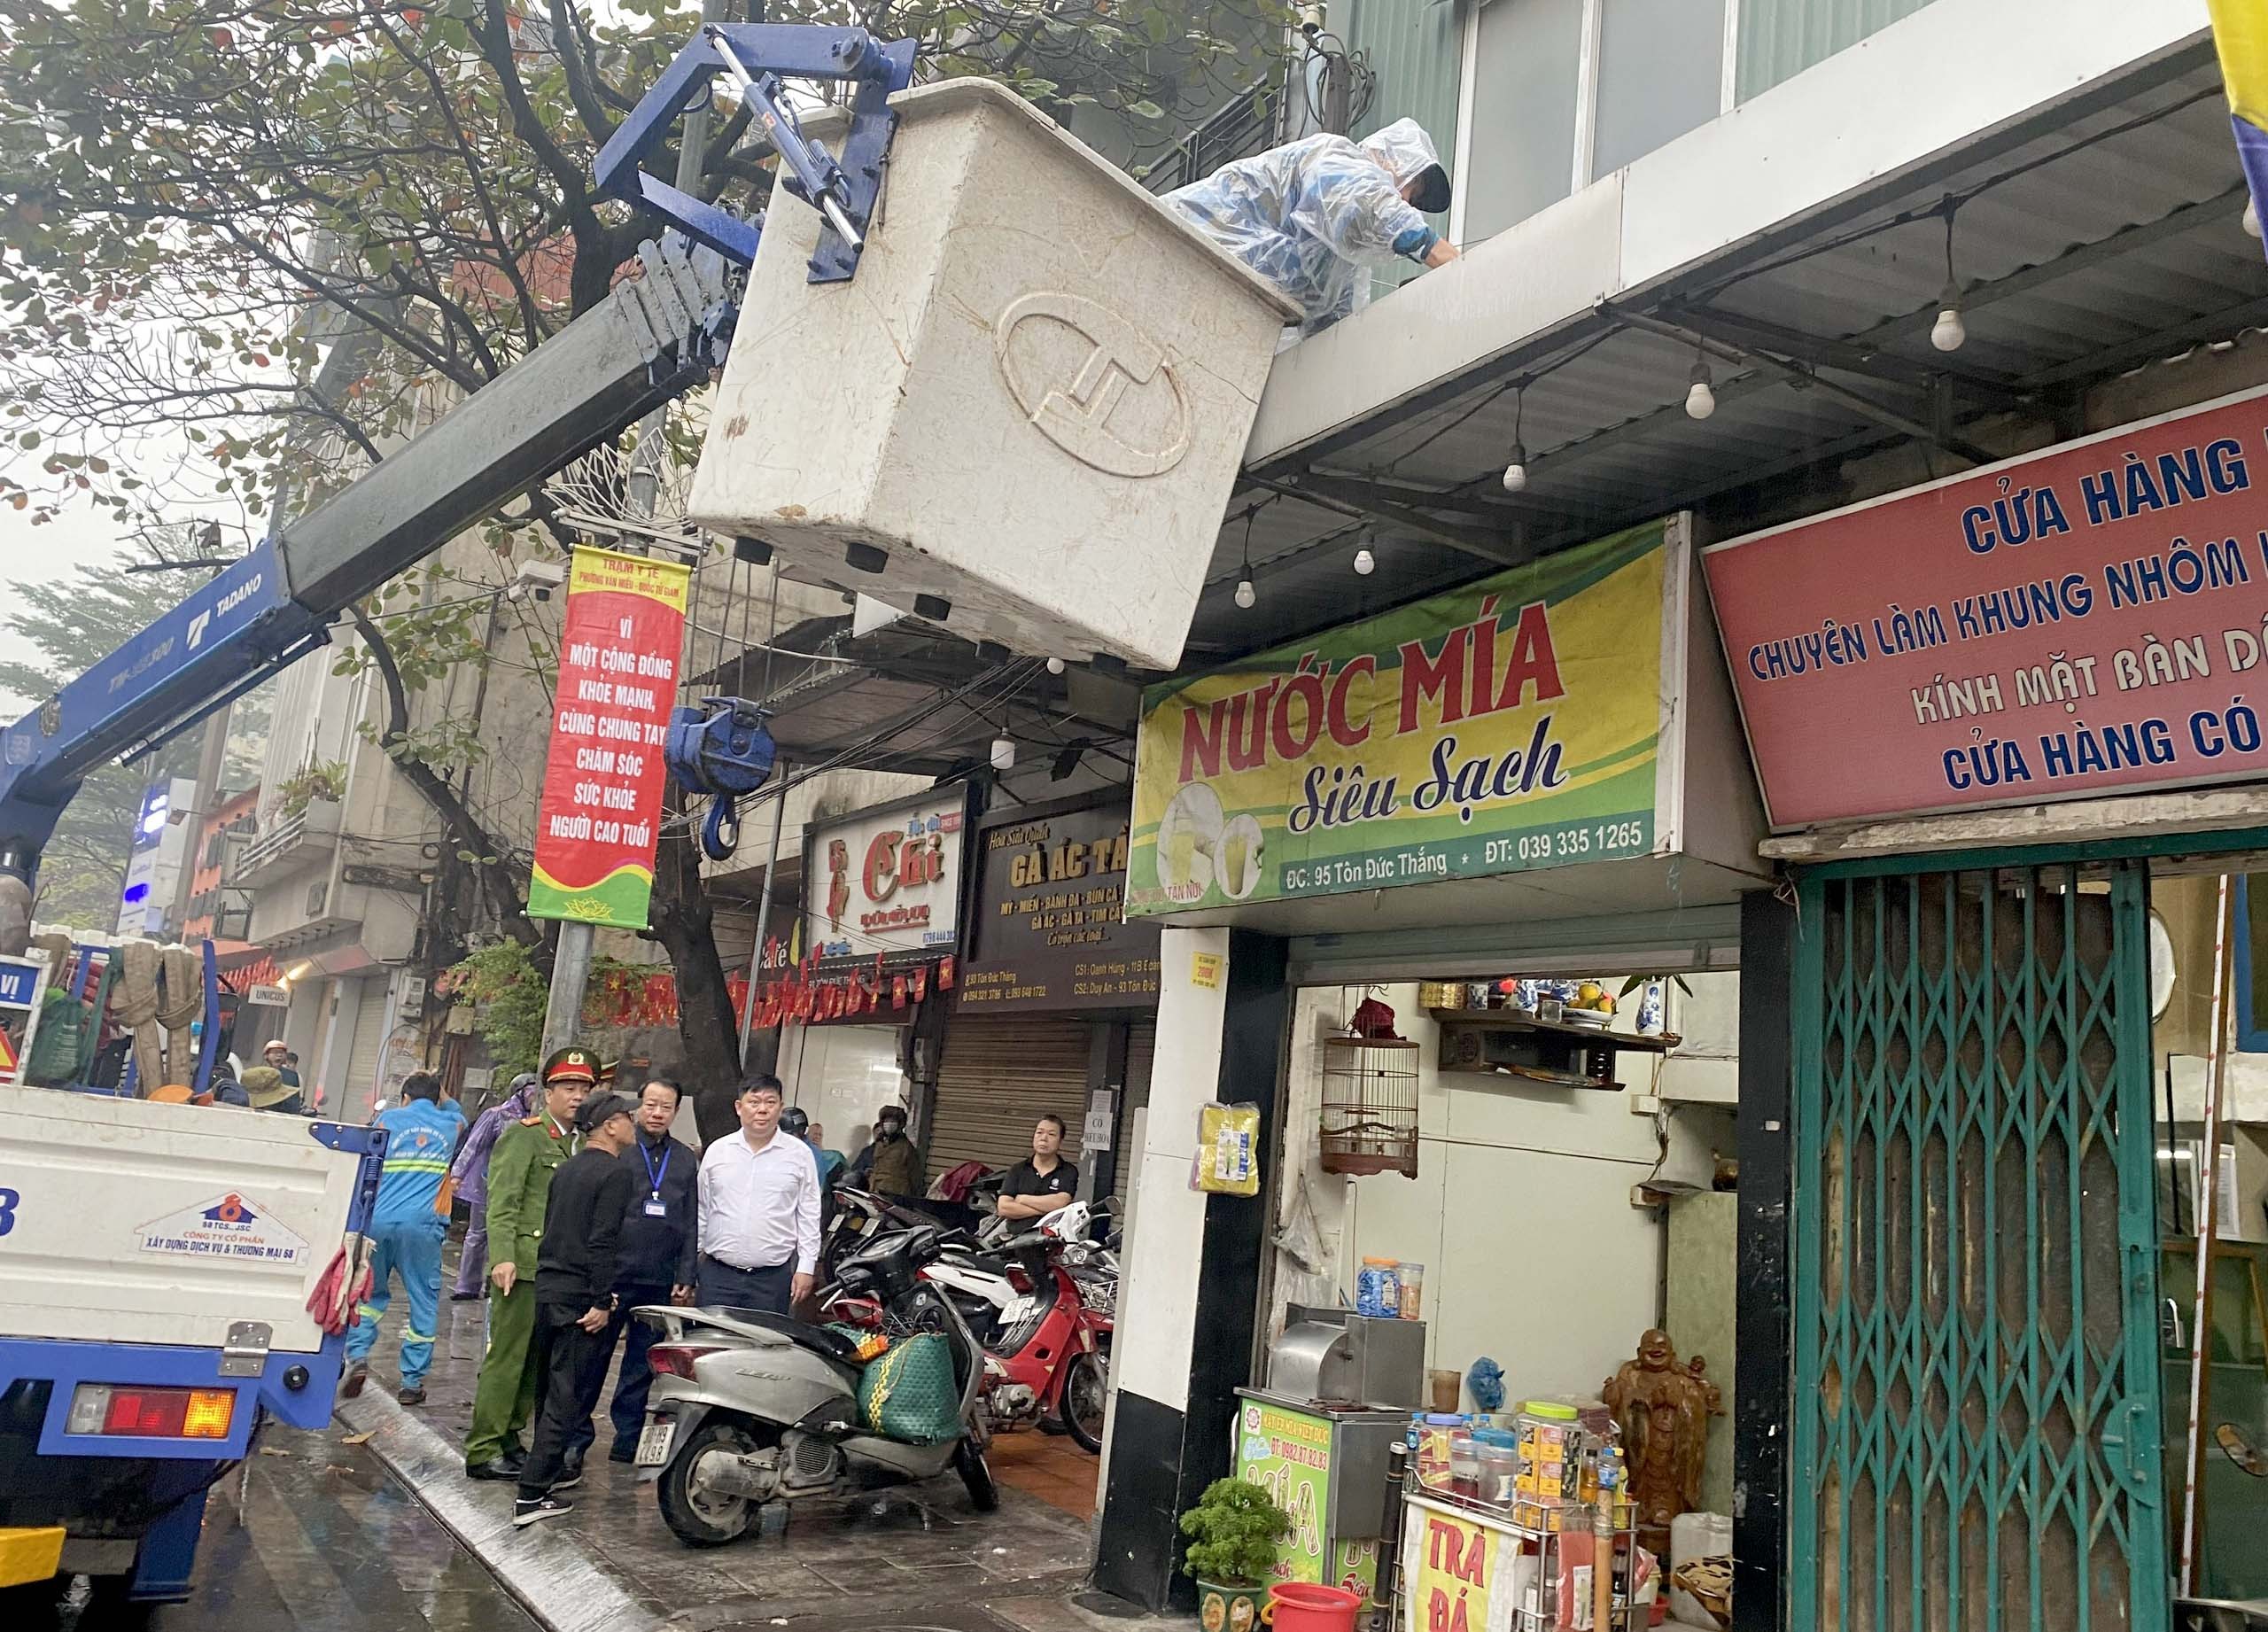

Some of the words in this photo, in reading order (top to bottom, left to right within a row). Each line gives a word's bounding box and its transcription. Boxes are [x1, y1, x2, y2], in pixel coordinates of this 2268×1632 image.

[1961, 477, 2070, 554] CỬA
[2082, 438, 2250, 526] HÀNG
[602, 559, 633, 574] TRẠM
[216, 574, 262, 618] TADANO
[1749, 619, 1868, 680] CHUYÊN
[1873, 604, 1948, 657] LÀM
[1952, 573, 2093, 641] KHUNG
[2104, 537, 2249, 609] NHÔM
[620, 615, 633, 638] VÌ
[570, 641, 599, 671] MỘT
[601, 646, 635, 674] CỘNG
[638, 650, 672, 680] ĐỒNG
[1911, 674, 2004, 725] KÍNH
[2016, 651, 2098, 713] MẶT
[2114, 634, 2211, 691] BÀN
[2222, 613, 2268, 672] D
[579, 673, 612, 703] KHỎE
[615, 685, 656, 712] MẠNH,
[1178, 649, 1378, 783] NƯỚC
[1396, 594, 1567, 737] MÍA
[559, 708, 595, 735] CÙNG
[598, 717, 641, 742] CHUNG
[644, 724, 666, 745] TAY
[1942, 727, 2031, 789] CỬA
[2039, 721, 2176, 777] HÀNG
[2189, 695, 2263, 758] CÓ
[577, 746, 615, 773] CHĂM
[617, 750, 643, 777] SÓC
[1289, 764, 1397, 833] Siêu
[1413, 716, 1568, 826] Sạch
[574, 778, 601, 806] SỨC
[603, 781, 637, 811] KHỎE
[550, 812, 592, 840] NGƯỜI
[594, 820, 619, 843] CAO
[623, 818, 650, 847] TUỔI
[1011, 843, 1043, 887] GÀ
[1049, 836, 1084, 880] ÁC
[1286, 870, 1310, 890] ĐC:
[1314, 866, 1331, 885] 95
[1333, 861, 1362, 885] Tôn
[1365, 853, 1394, 879] Đức
[1397, 847, 1448, 879] Thắng
[1485, 838, 1512, 864] ĐT:
[1518, 835, 1551, 860] 039
[1557, 829, 1589, 853] 335
[1595, 821, 1643, 850] 1265
[1045, 893, 1067, 910] BÁNH
[1091, 908, 1107, 922] TIM
[255, 990, 285, 1001] UNICUS
[146, 1237, 163, 1248] XÂY
[166, 1239, 188, 1251] DỰNG
[190, 1241, 209, 1254] DỊCH
[212, 1244, 221, 1255] VỤ
[224, 1244, 230, 1253] &
[266, 1247, 282, 1260] MẠI
[284, 1248, 293, 1259] 68
[183, 1231, 209, 1240] CÔNG
[1428, 1519, 1487, 1588] TRÀ
[1427, 1587, 1469, 1632] ĐÁ
